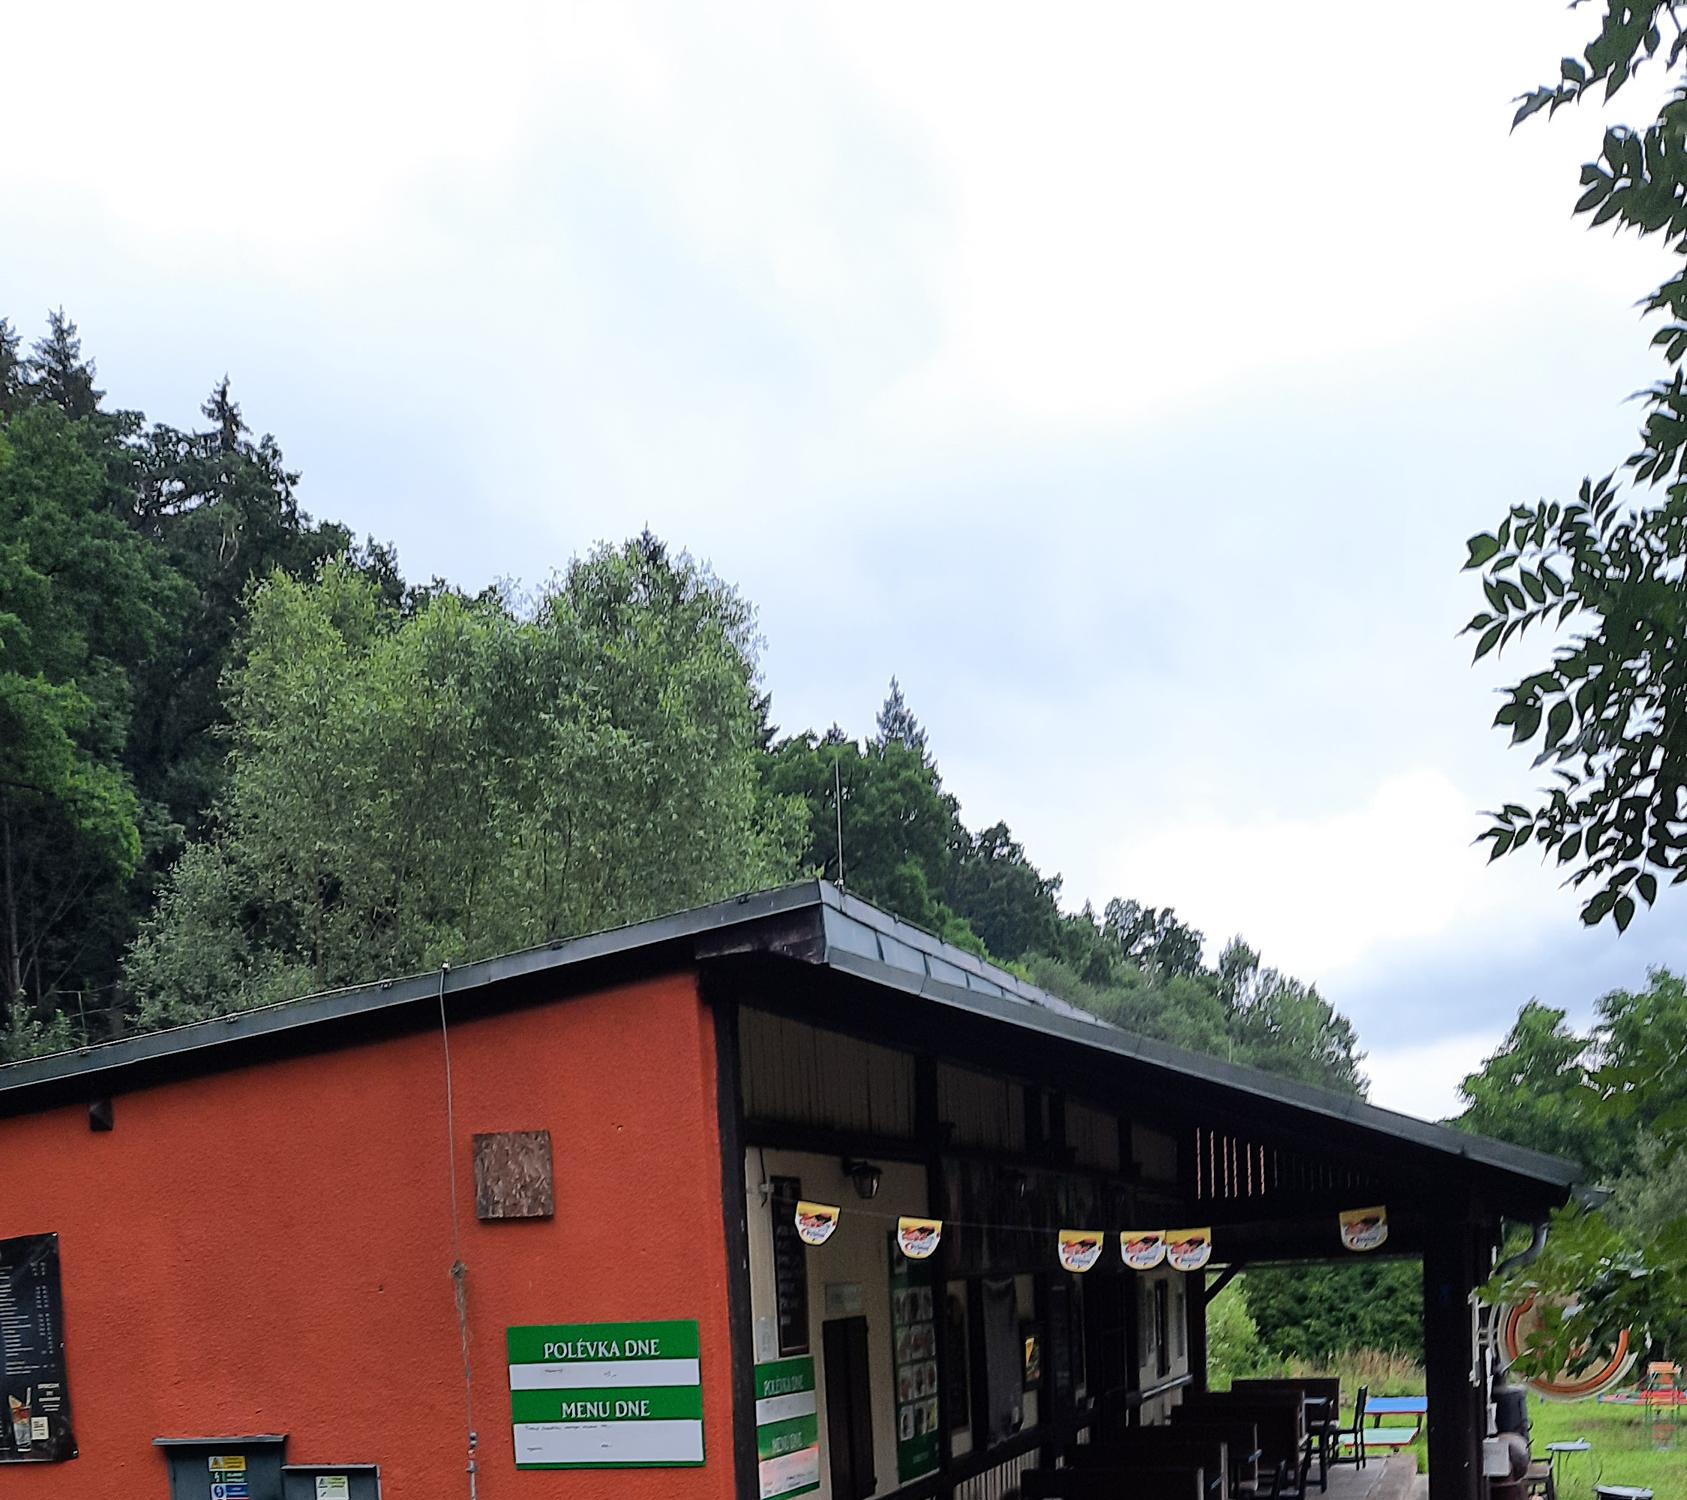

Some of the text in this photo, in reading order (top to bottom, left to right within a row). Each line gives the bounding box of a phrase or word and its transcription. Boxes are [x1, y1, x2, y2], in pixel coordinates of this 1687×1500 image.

[543, 1338, 661, 1359] POLÉVKA DNE
[561, 1399, 651, 1418] MENU DNE
